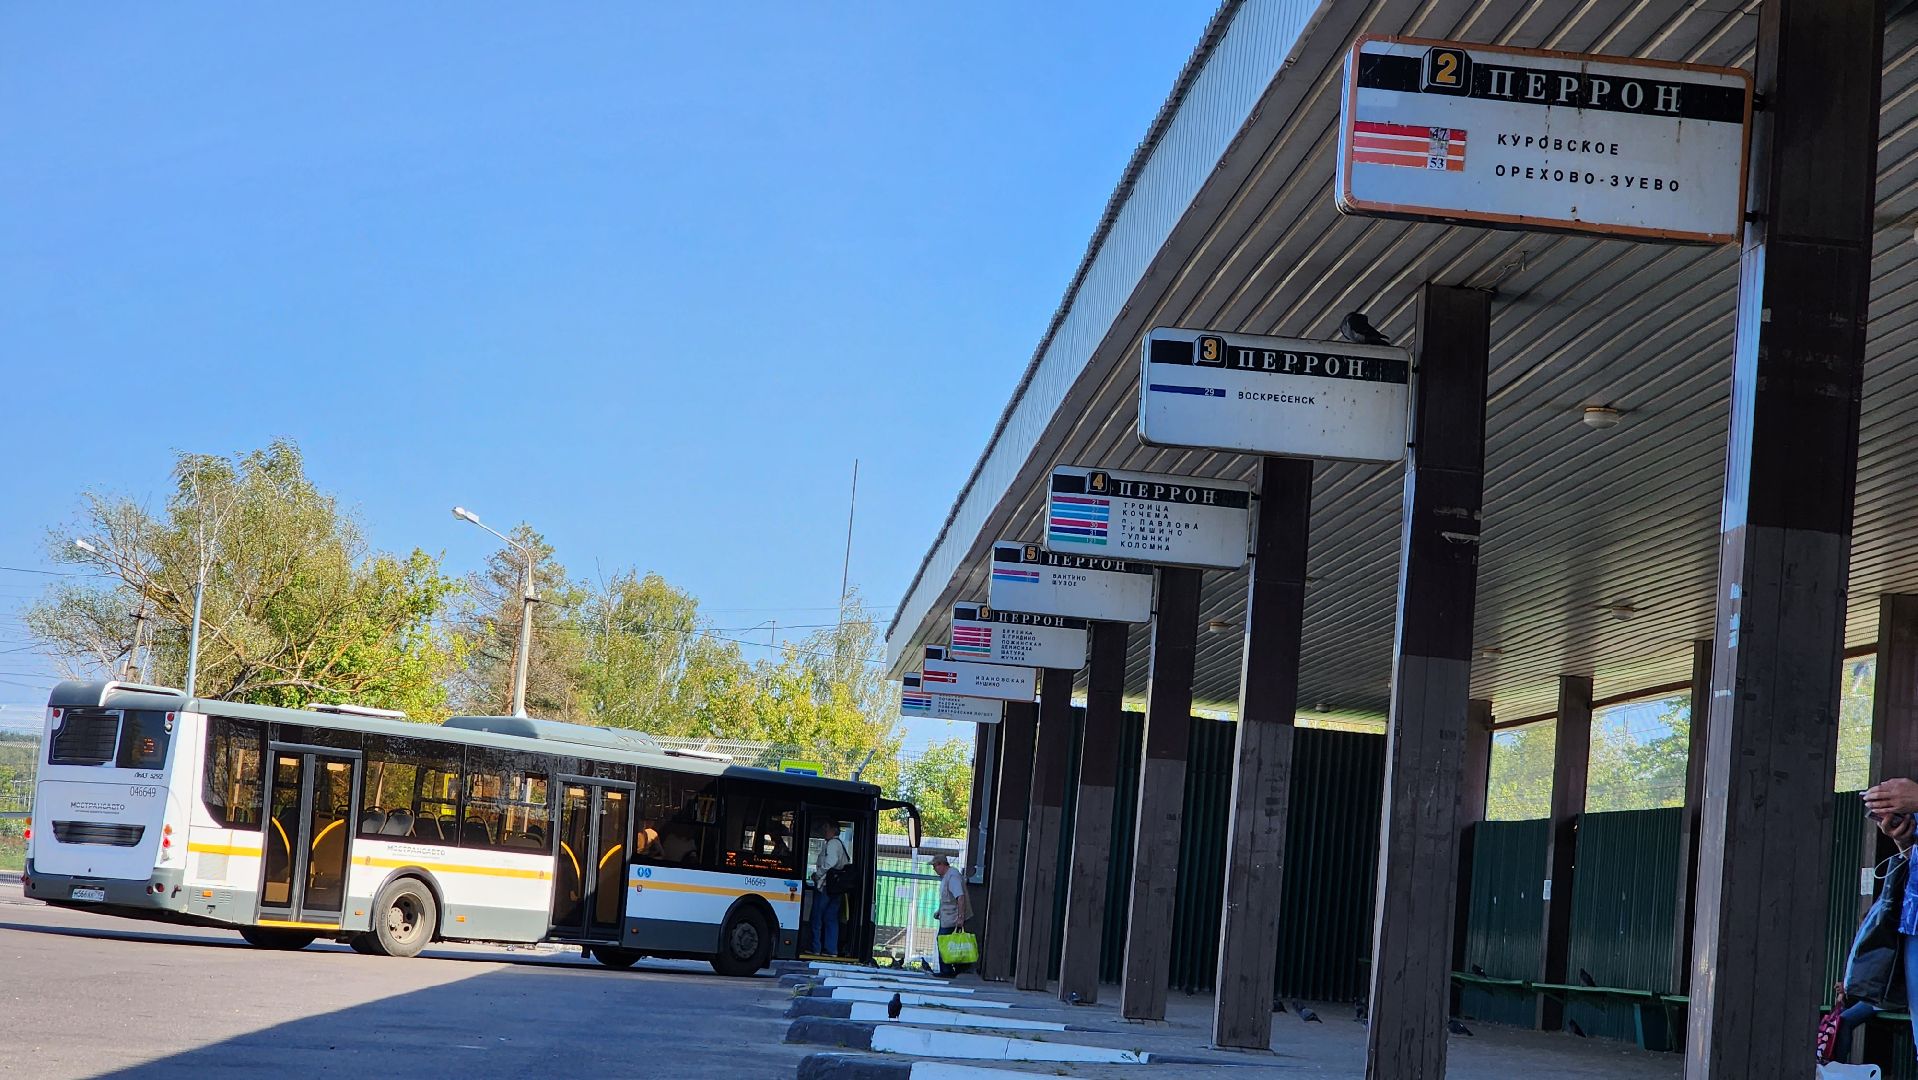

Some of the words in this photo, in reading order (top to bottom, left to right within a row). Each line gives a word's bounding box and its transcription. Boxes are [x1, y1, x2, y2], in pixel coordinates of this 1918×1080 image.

[1436, 53, 1457, 84] 2
[1488, 69, 1681, 113] ПЕРРОН
[1498, 133, 1619, 155] КУРОВСКОЕ
[1430, 157, 1444, 169] 53
[1495, 165, 1680, 192] ОРЕХОВО-ЗУЕВО
[1203, 339, 1217, 360] 3
[1237, 350, 1364, 377] ПЕРРОН
[1204, 387, 1215, 396] 29
[1238, 391, 1315, 405] ВОСКРЕСЕНСК
[1093, 474, 1104, 490] 4
[1118, 481, 1216, 505] ПЕРРОН
[1123, 502, 1169, 512] ТРОИЦА
[1122, 510, 1169, 519] КОЧЕМА
[1121, 525, 1183, 536] ТИМШИНО
[1120, 541, 1170, 551] КОЛОМНА
[1026, 547, 1036, 560] 5
[1048, 553, 1126, 572] ПЕРРОН
[998, 612, 1064, 627] ПЕРРОН
[129, 786, 157, 798] 046649
[70, 801, 126, 811] МОСТРАНСАВТО
